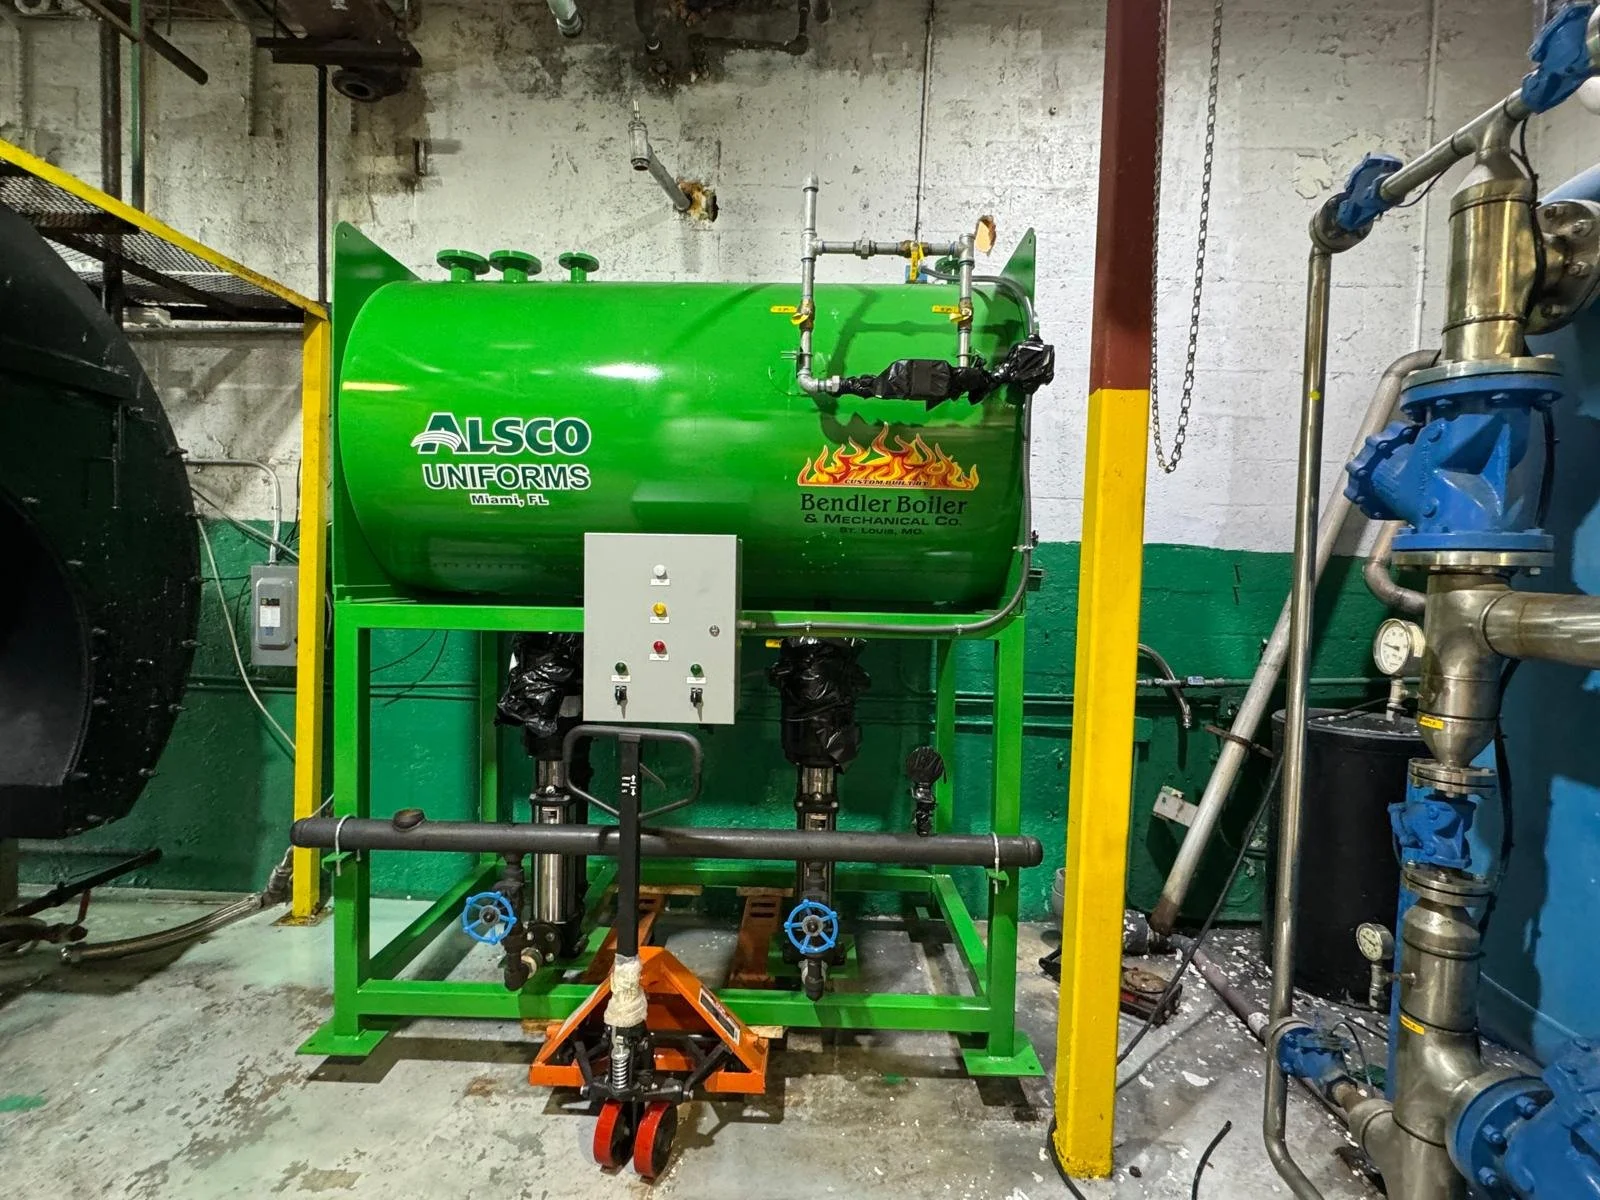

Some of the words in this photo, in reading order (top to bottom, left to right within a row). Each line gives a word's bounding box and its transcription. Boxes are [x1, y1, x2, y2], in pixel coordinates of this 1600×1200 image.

[411, 412, 591, 455] ALSCO
[422, 464, 591, 490] UNIFORMS
[470, 493, 524, 507] Miami,
[527, 494, 550, 506] FL
[801, 493, 891, 513] Bendler
[896, 496, 968, 515] Boiler
[803, 513, 818, 524] &
